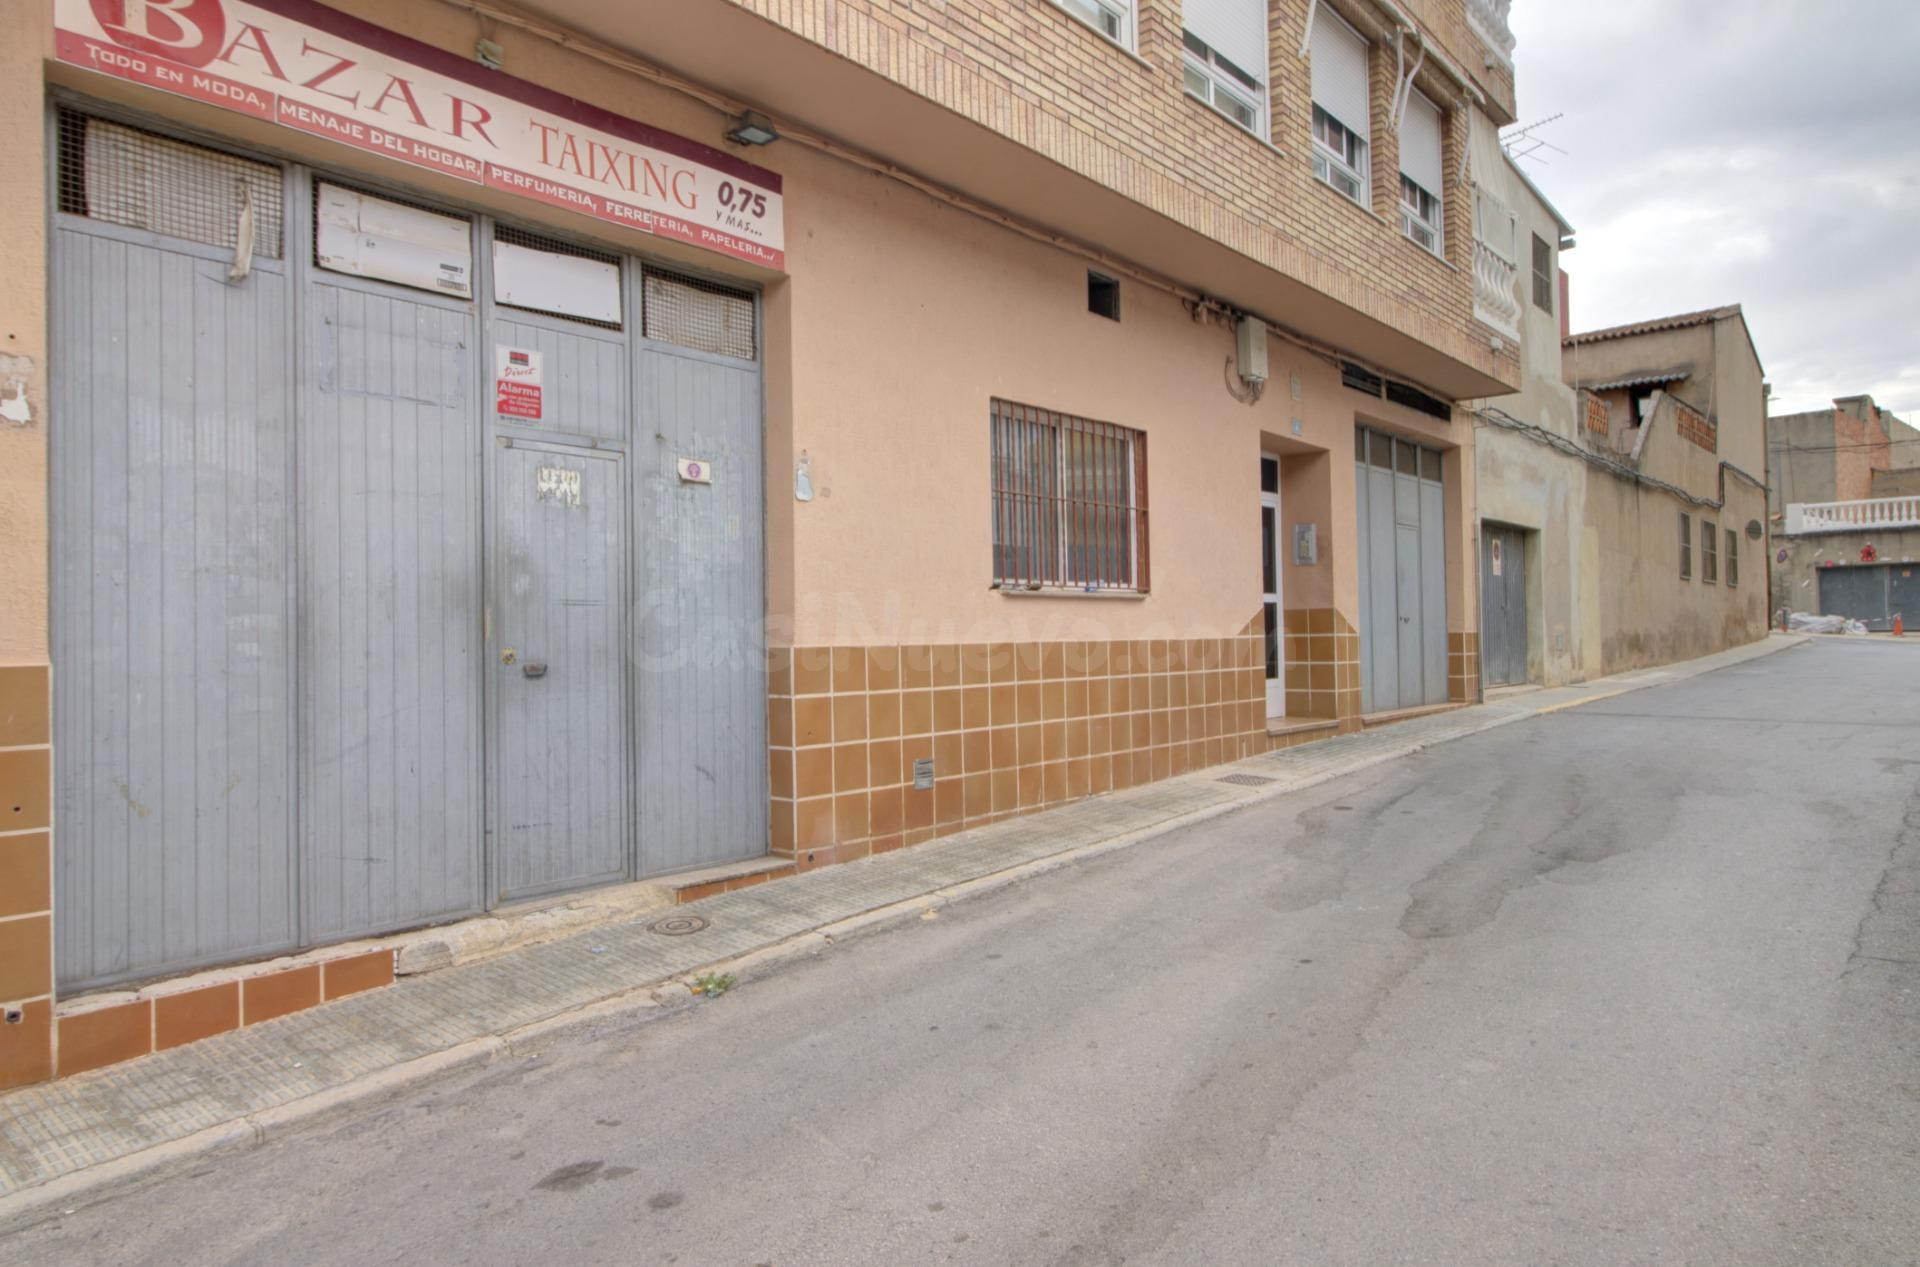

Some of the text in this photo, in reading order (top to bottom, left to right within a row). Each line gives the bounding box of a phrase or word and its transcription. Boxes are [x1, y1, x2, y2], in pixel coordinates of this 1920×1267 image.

[84, 42, 147, 72] TODO
[155, 65, 184, 85] EN
[193, 75, 267, 110] MODA,
[280, 101, 364, 140] MENAJE
[370, 130, 409, 154] DEL
[413, 142, 482, 176] HOGAR,
[491, 165, 598, 214] PERFUMERIA,
[605, 200, 694, 238] FERRETERIA,
[104, 0, 699, 210] BAZAR TAIXING
[717, 180, 767, 219] 0,75
[500, 382, 540, 397] Alarma
